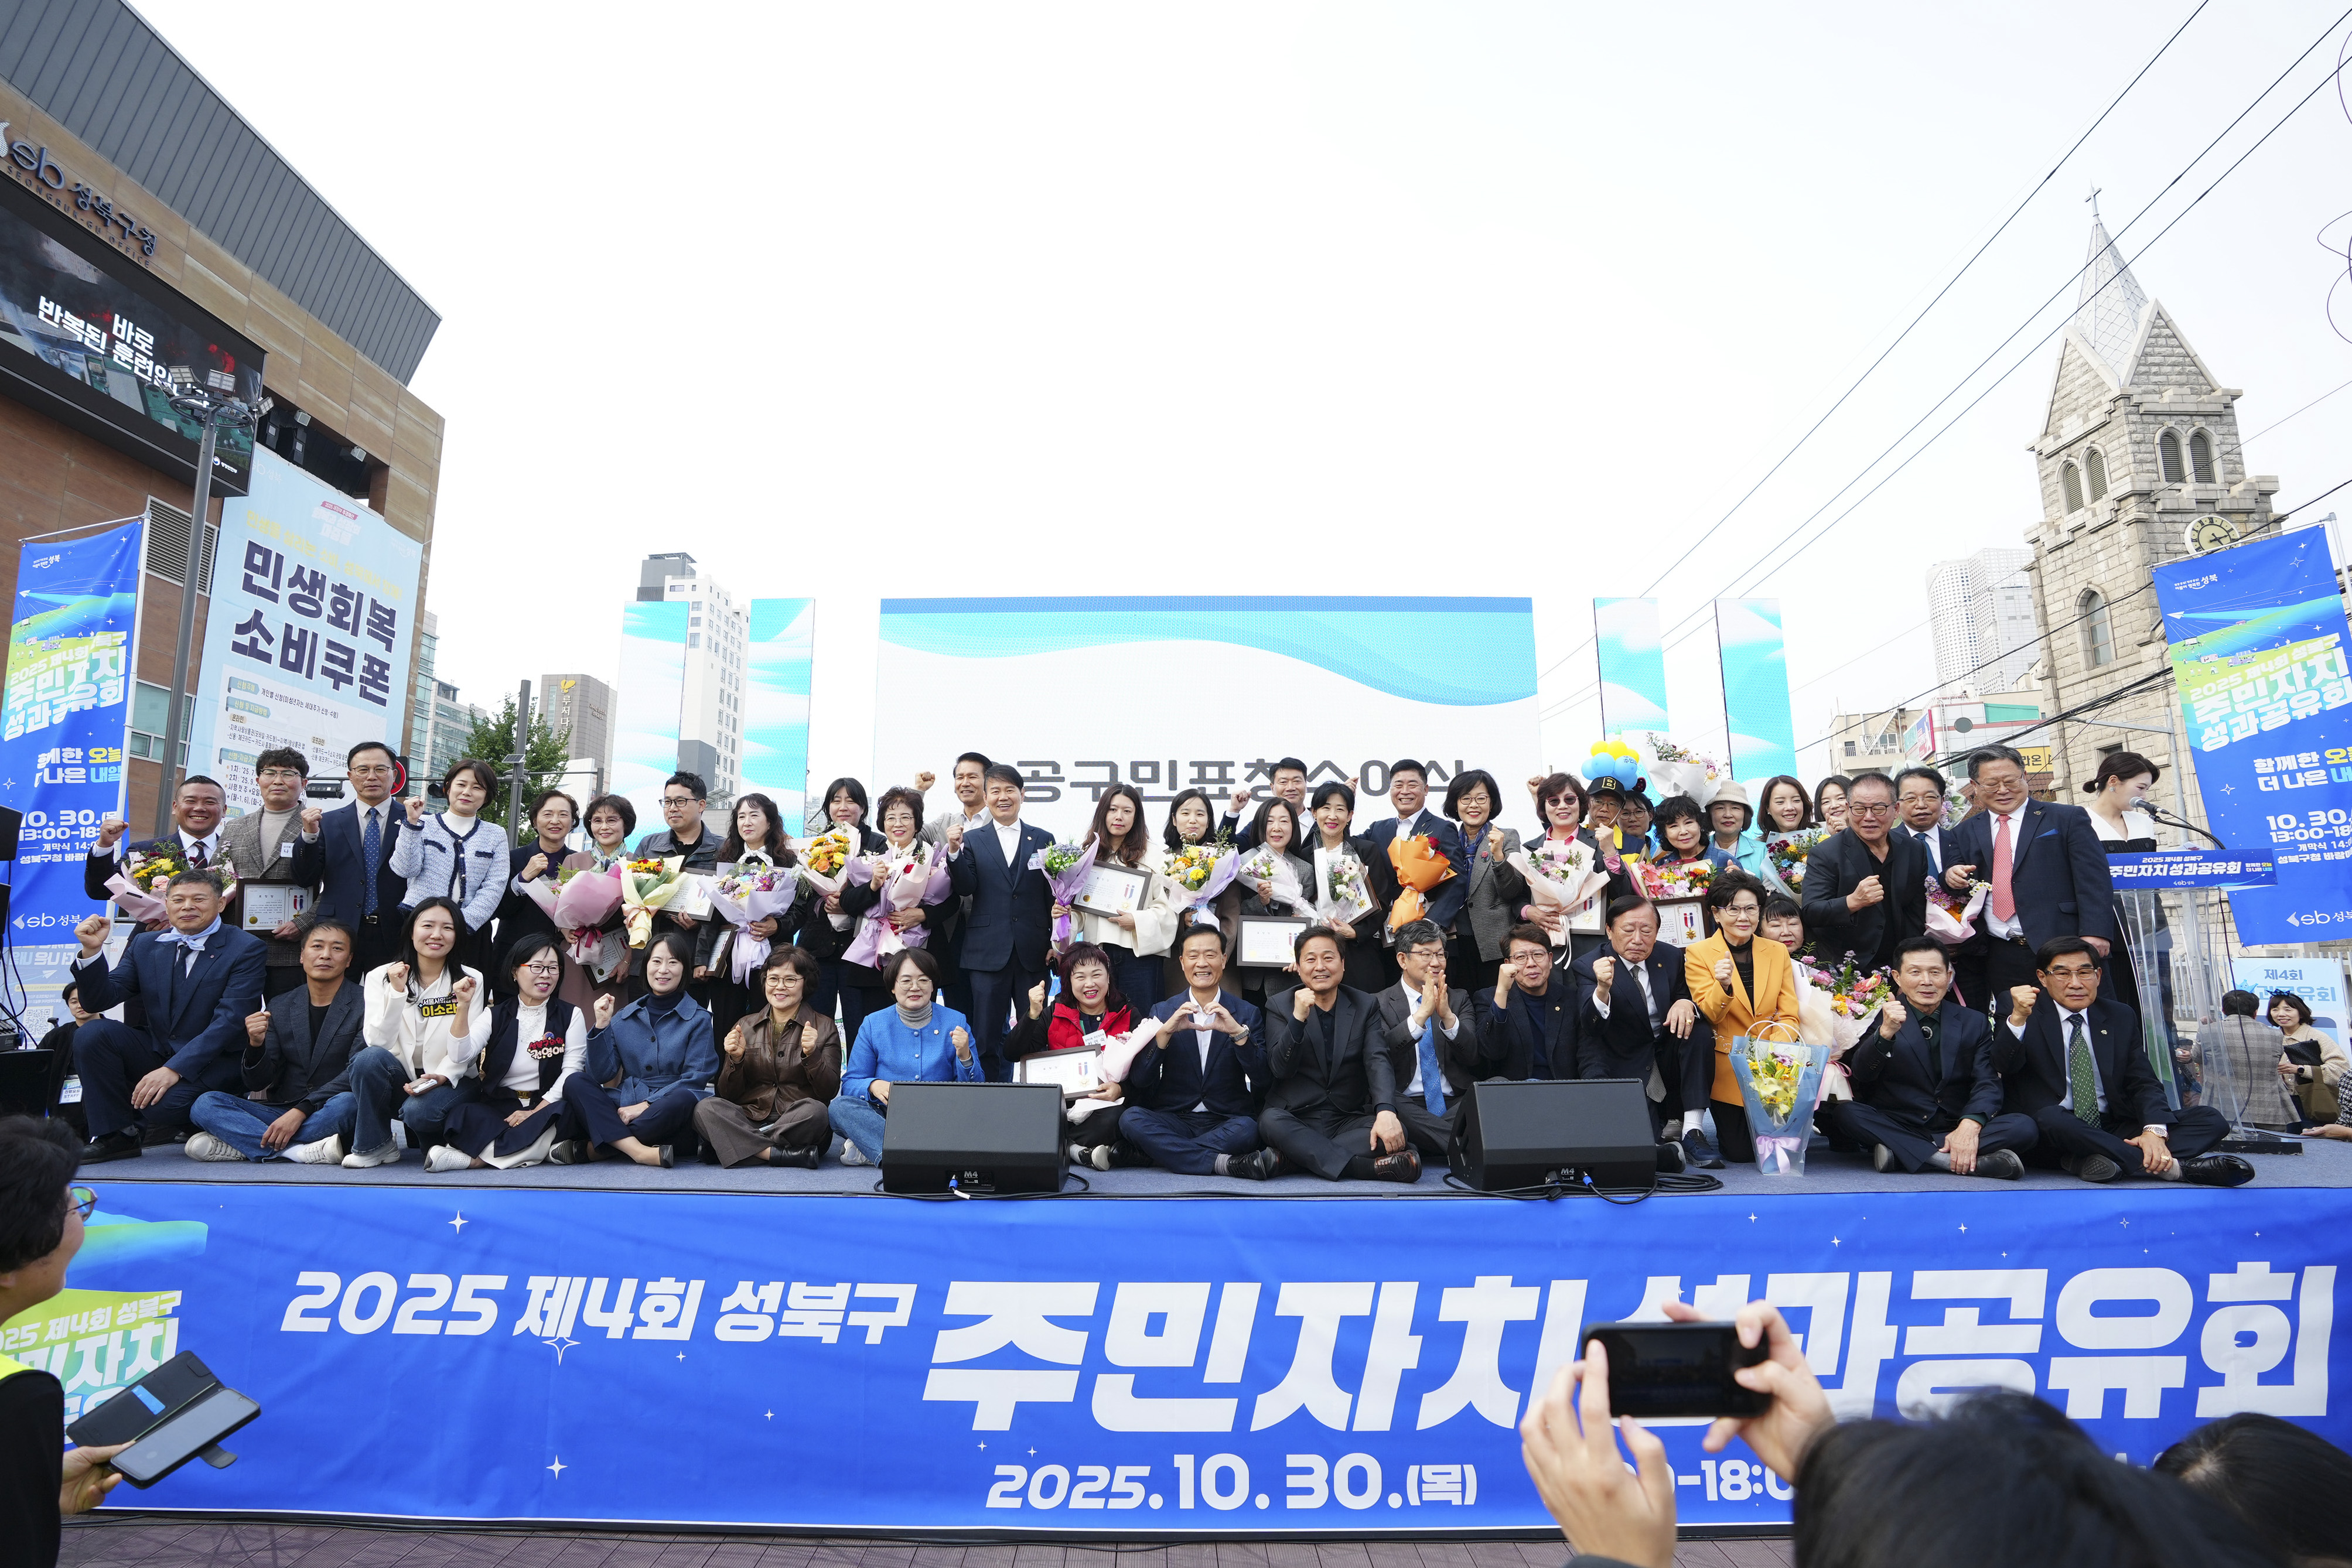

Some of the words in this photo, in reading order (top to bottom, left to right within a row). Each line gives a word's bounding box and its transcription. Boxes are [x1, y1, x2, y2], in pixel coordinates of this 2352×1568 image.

[6, 165, 102, 235] SEONGBUK-GU
[108, 235, 150, 268] OFFICE
[67, 182, 157, 256] 성북구청
[38, 295, 107, 354] 반복된
[112, 313, 153, 356] 바로
[284, 529, 317, 558] 살리는
[49, 554, 60, 564] 성북
[2201, 573, 2218, 585] 성북
[241, 539, 397, 654] 민생회복
[10, 658, 47, 685] 2025
[50, 645, 88, 667] 제4회
[231, 607, 391, 708] 소비쿠폰
[2190, 672, 2242, 701] 2025
[2245, 653, 2289, 681] 제4회
[2291, 632, 2341, 660] 성북구
[237, 680, 255, 692] 신청주체
[261, 688, 274, 698] 개인별
[2193, 646, 2350, 725] 주민자치
[234, 700, 244, 708] 신청
[250, 703, 268, 716] 지급방법
[2200, 676, 2352, 752] 성과공유회
[231, 714, 244, 723] 온라인
[89, 747, 121, 763] 오늘
[2254, 751, 2320, 774] 함께한
[2324, 747, 2352, 765] 오
[43, 767, 86, 784] 나은
[90, 766, 121, 783] 내일
[2257, 776, 2280, 791] 더
[2282, 769, 2329, 789] 나은
[2330, 766, 2352, 783] 내
[228, 783, 238, 791] 시행
[1601, 777, 1617, 790] B
[2266, 814, 2306, 831] 10.
[2308, 809, 2352, 826] 30.
[19, 826, 100, 841] 13:00-18:
[2269, 825, 2351, 843] 13:00-18
[42, 843, 70, 851] 개막식
[2298, 842, 2327, 852] 개막식
[20, 853, 62, 865] 성북구청
[64, 853, 87, 862] 바람
[2278, 853, 2322, 864] 성북구청
[2109, 865, 2167, 877] 주민자치
[2169, 862, 2242, 876] 성과공유회
[26, 913, 56, 928] sb
[57, 914, 83, 927] 성북
[2300, 910, 2330, 925] sb
[2264, 969, 2303, 981] 제4회
[2257, 986, 2337, 1002] 과유회
[422, 1003, 458, 1017] 이소라
[529, 1037, 564, 1050] 성북구의원
[530, 1046, 565, 1060] 권영애
[43, 1306, 112, 1342] 제4회
[117, 1290, 182, 1325] 성북구
[280, 1271, 508, 1335] 2025
[513, 1276, 705, 1341] 제4회
[714, 1281, 917, 1344] 성북구
[922, 1276, 1588, 1432] 주민자치
